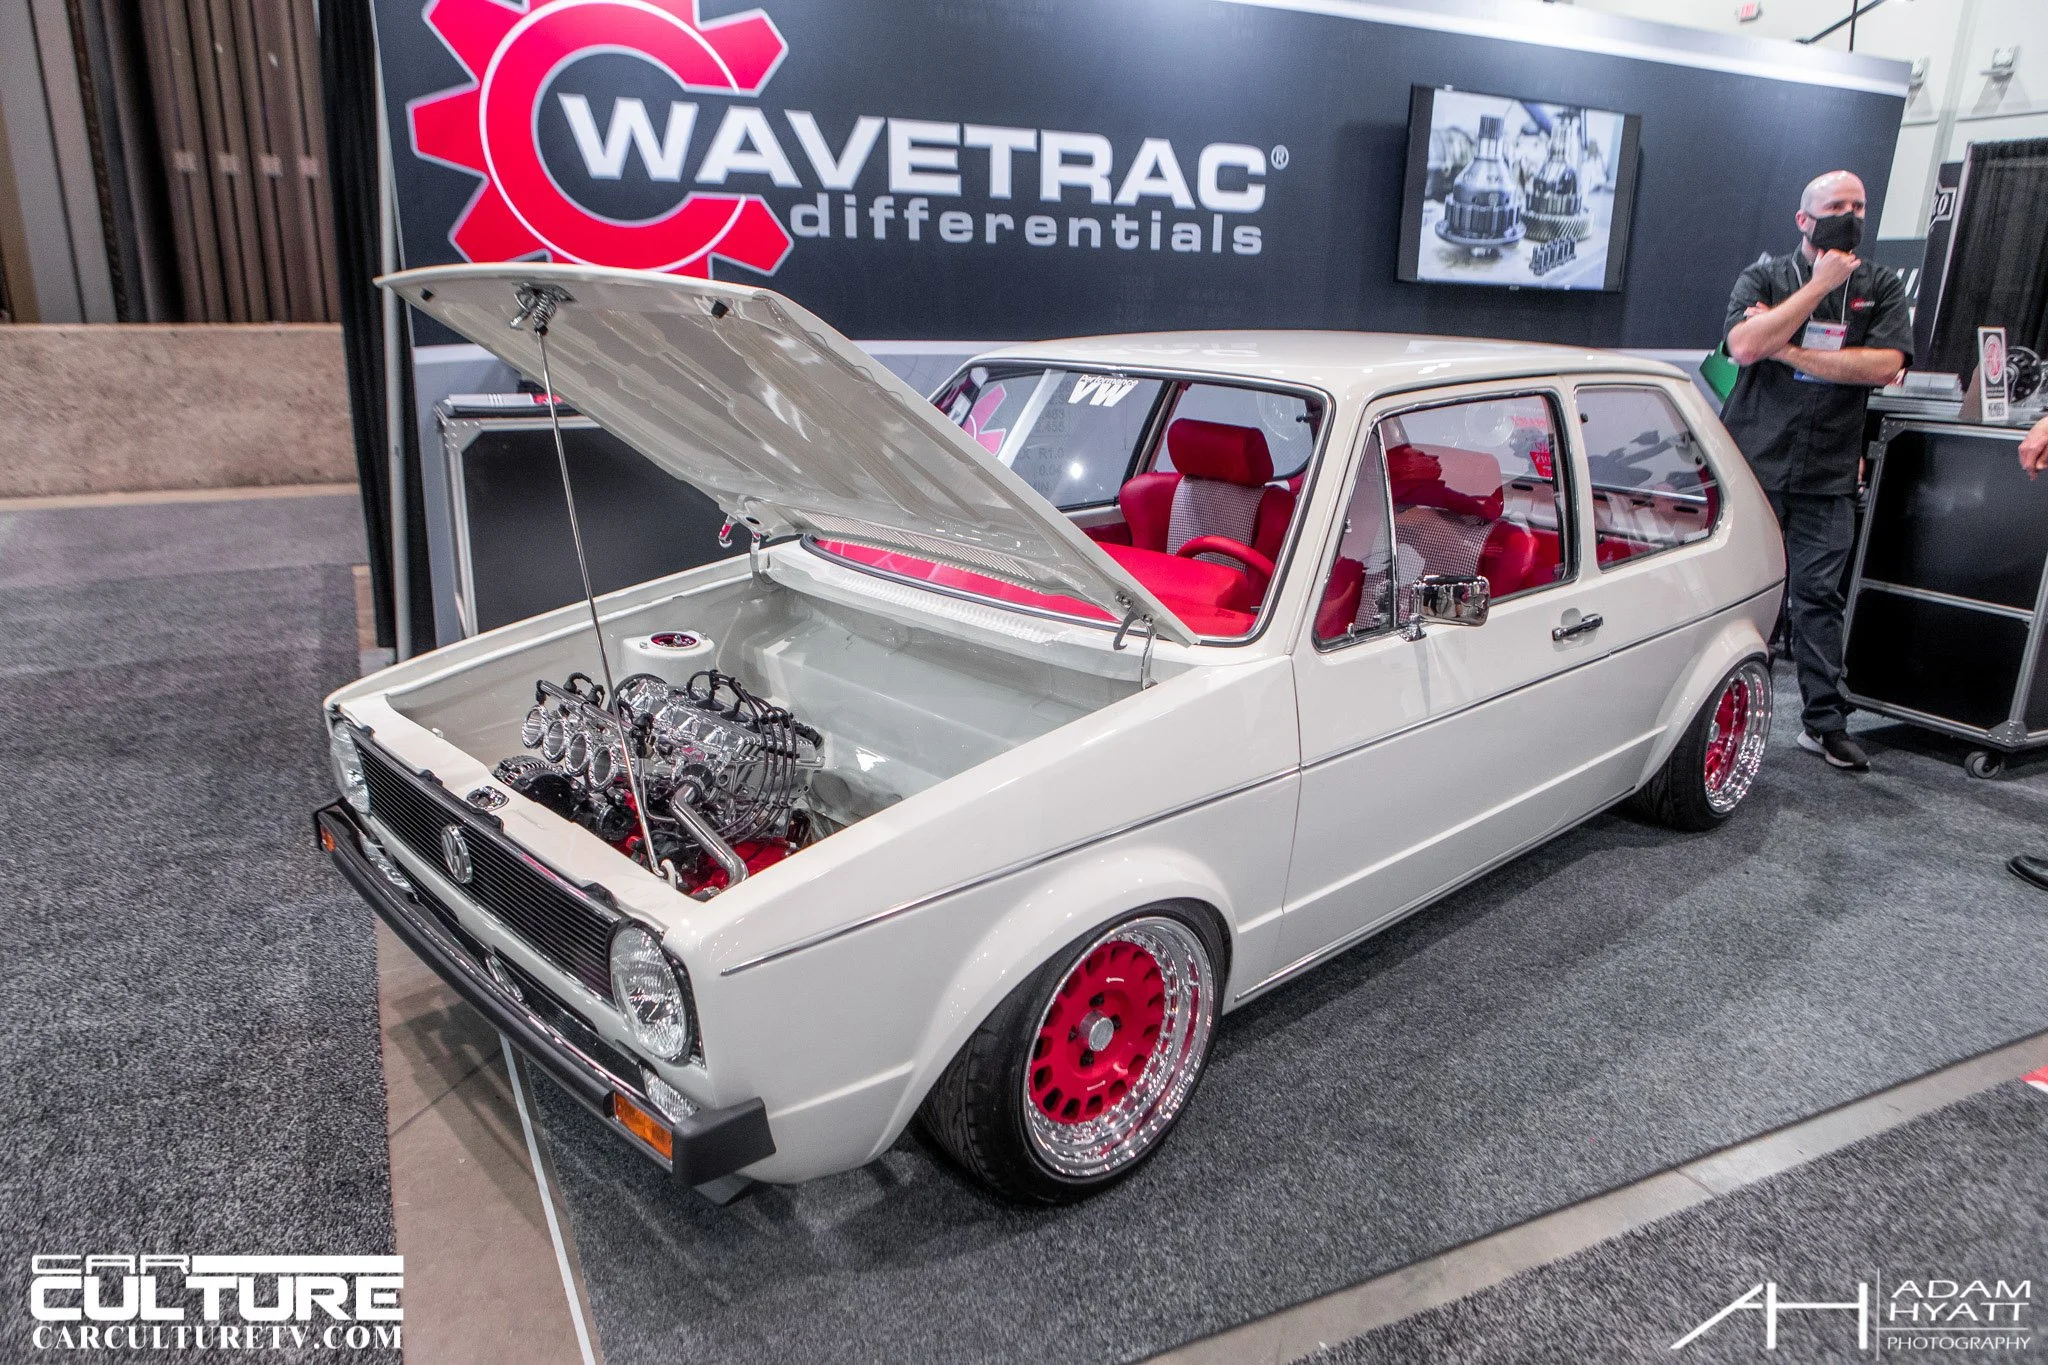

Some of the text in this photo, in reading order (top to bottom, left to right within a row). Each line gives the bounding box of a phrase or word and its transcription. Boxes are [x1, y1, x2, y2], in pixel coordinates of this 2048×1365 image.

[789, 192, 1263, 256] differentials
[1067, 376, 1138, 407] VW
[1079, 374, 1139, 386] Performance
